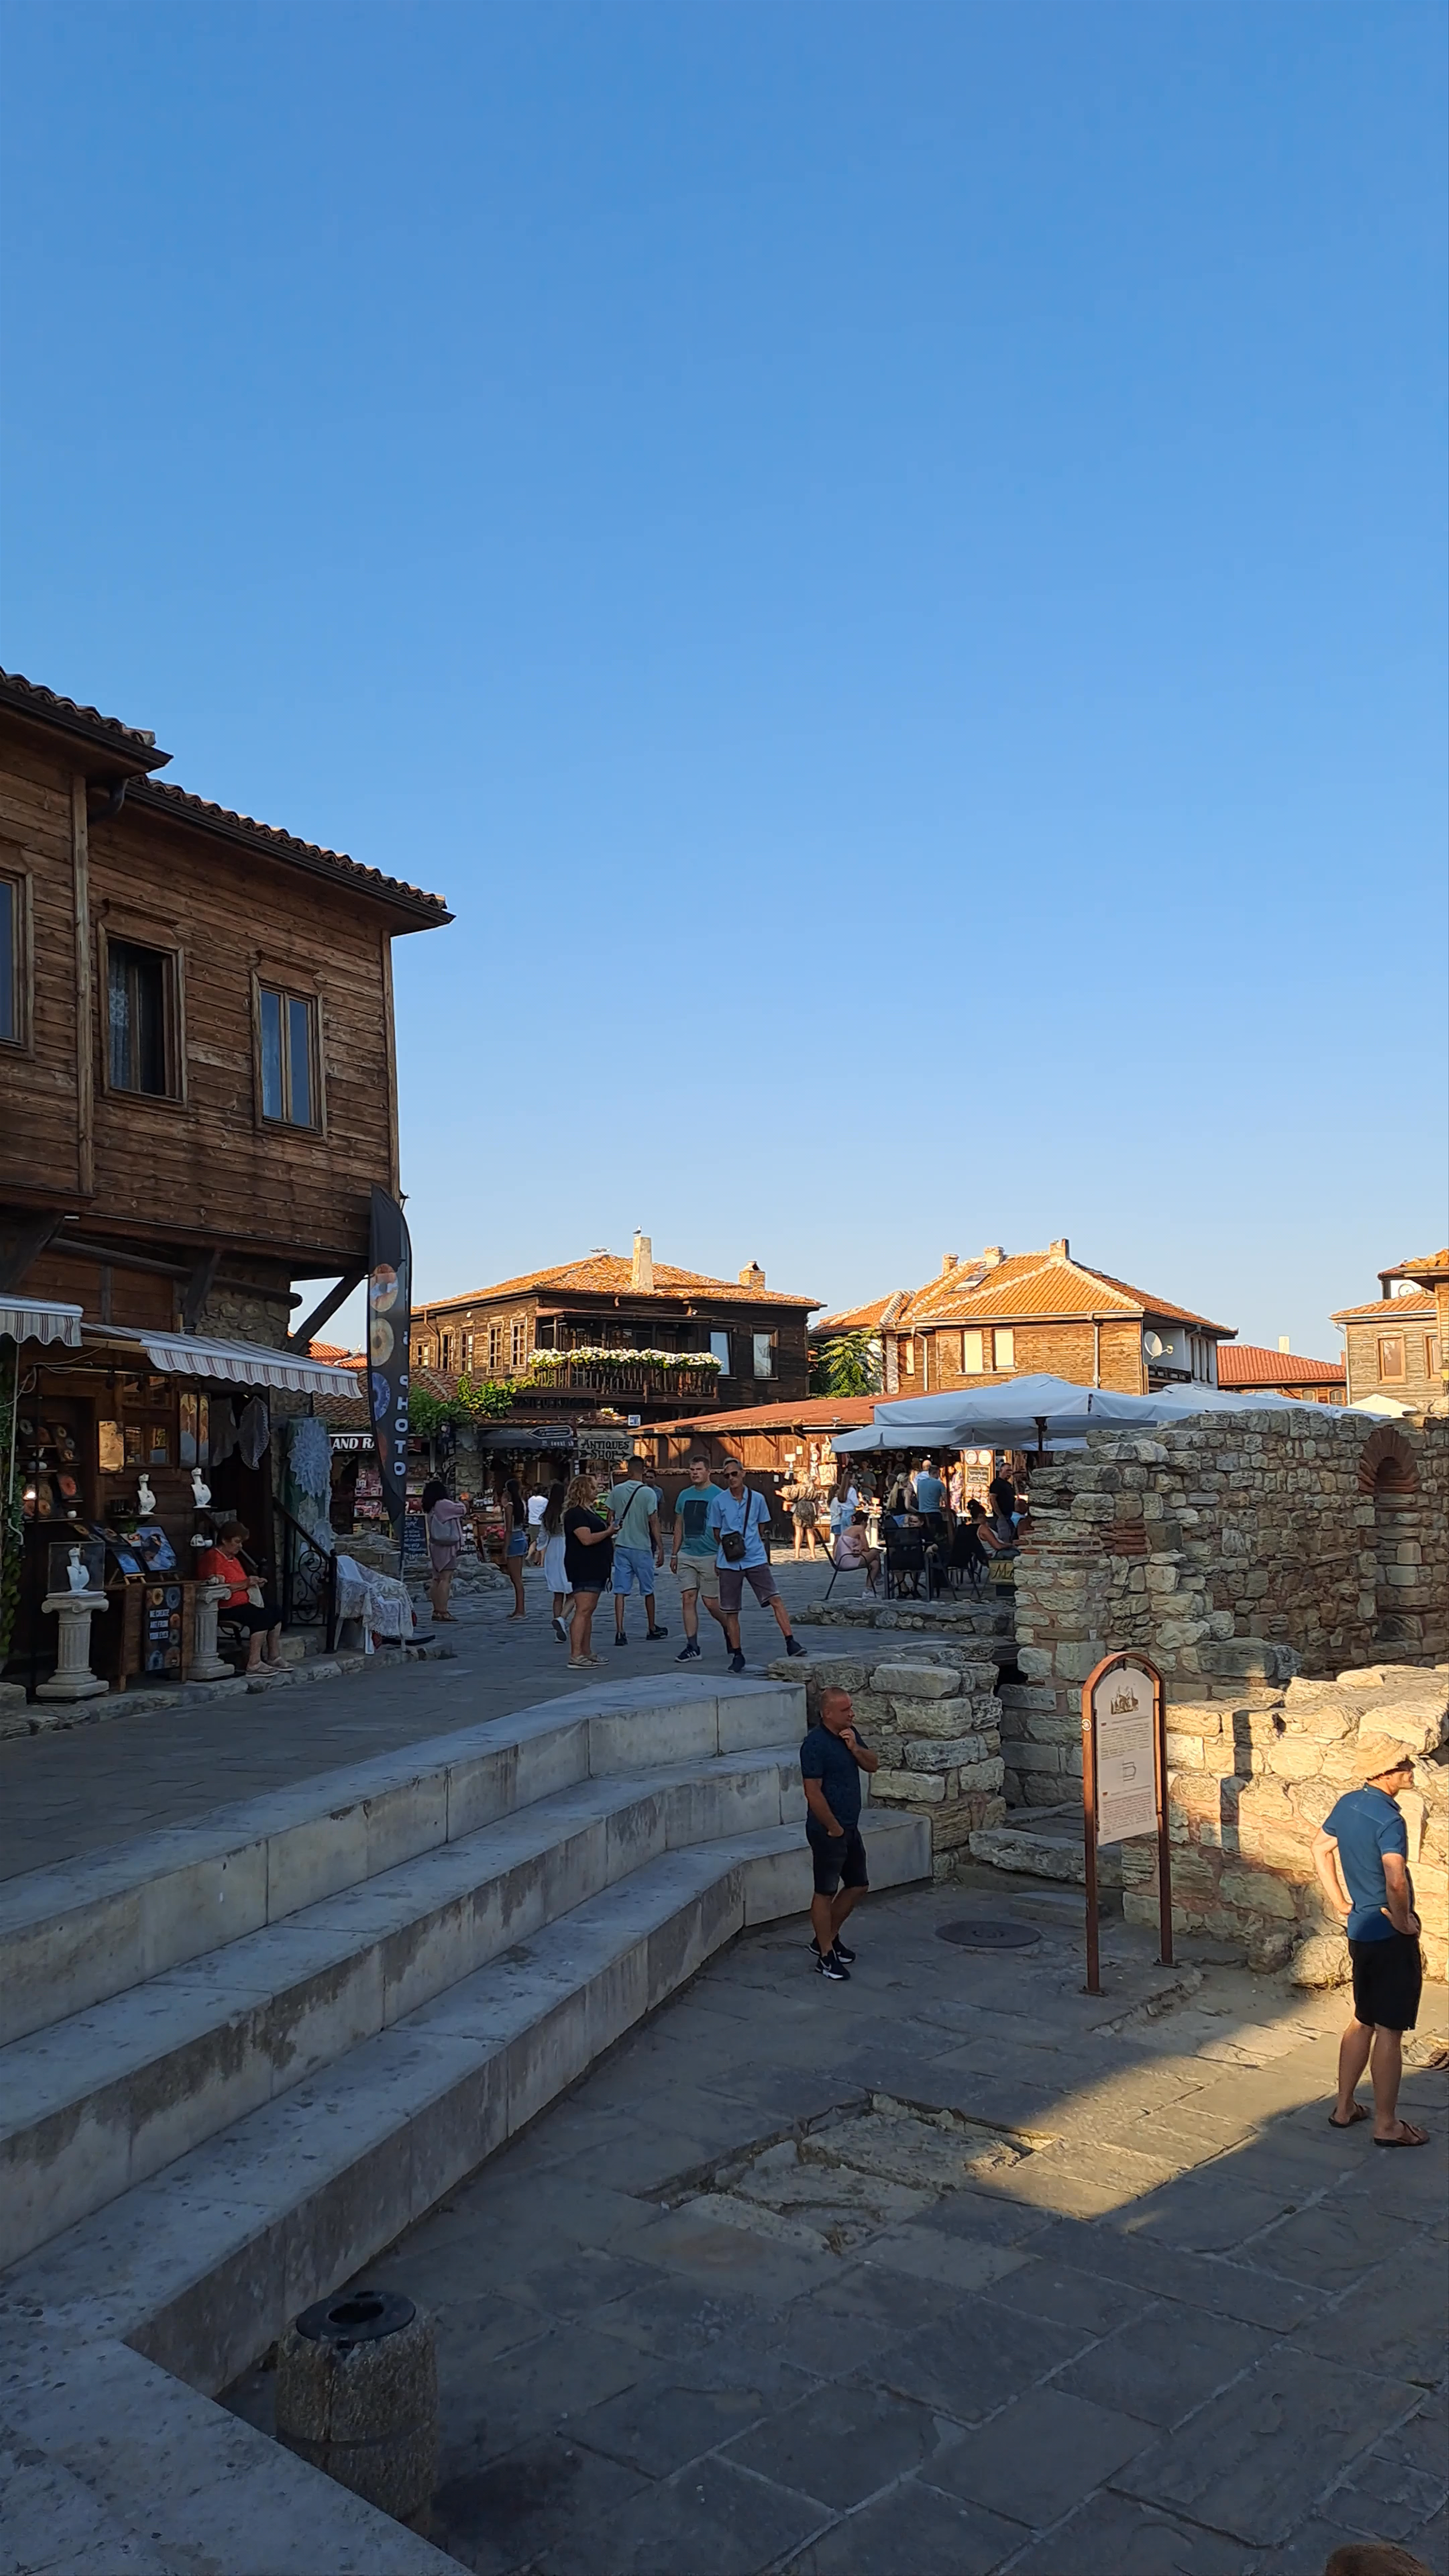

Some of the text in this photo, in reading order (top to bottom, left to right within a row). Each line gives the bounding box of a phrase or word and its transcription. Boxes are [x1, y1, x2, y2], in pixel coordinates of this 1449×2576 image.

[332, 1438, 358, 1449] AND
[581, 1438, 630, 1449] ANTIQUES
[591, 1449, 618, 1460] SHOP
